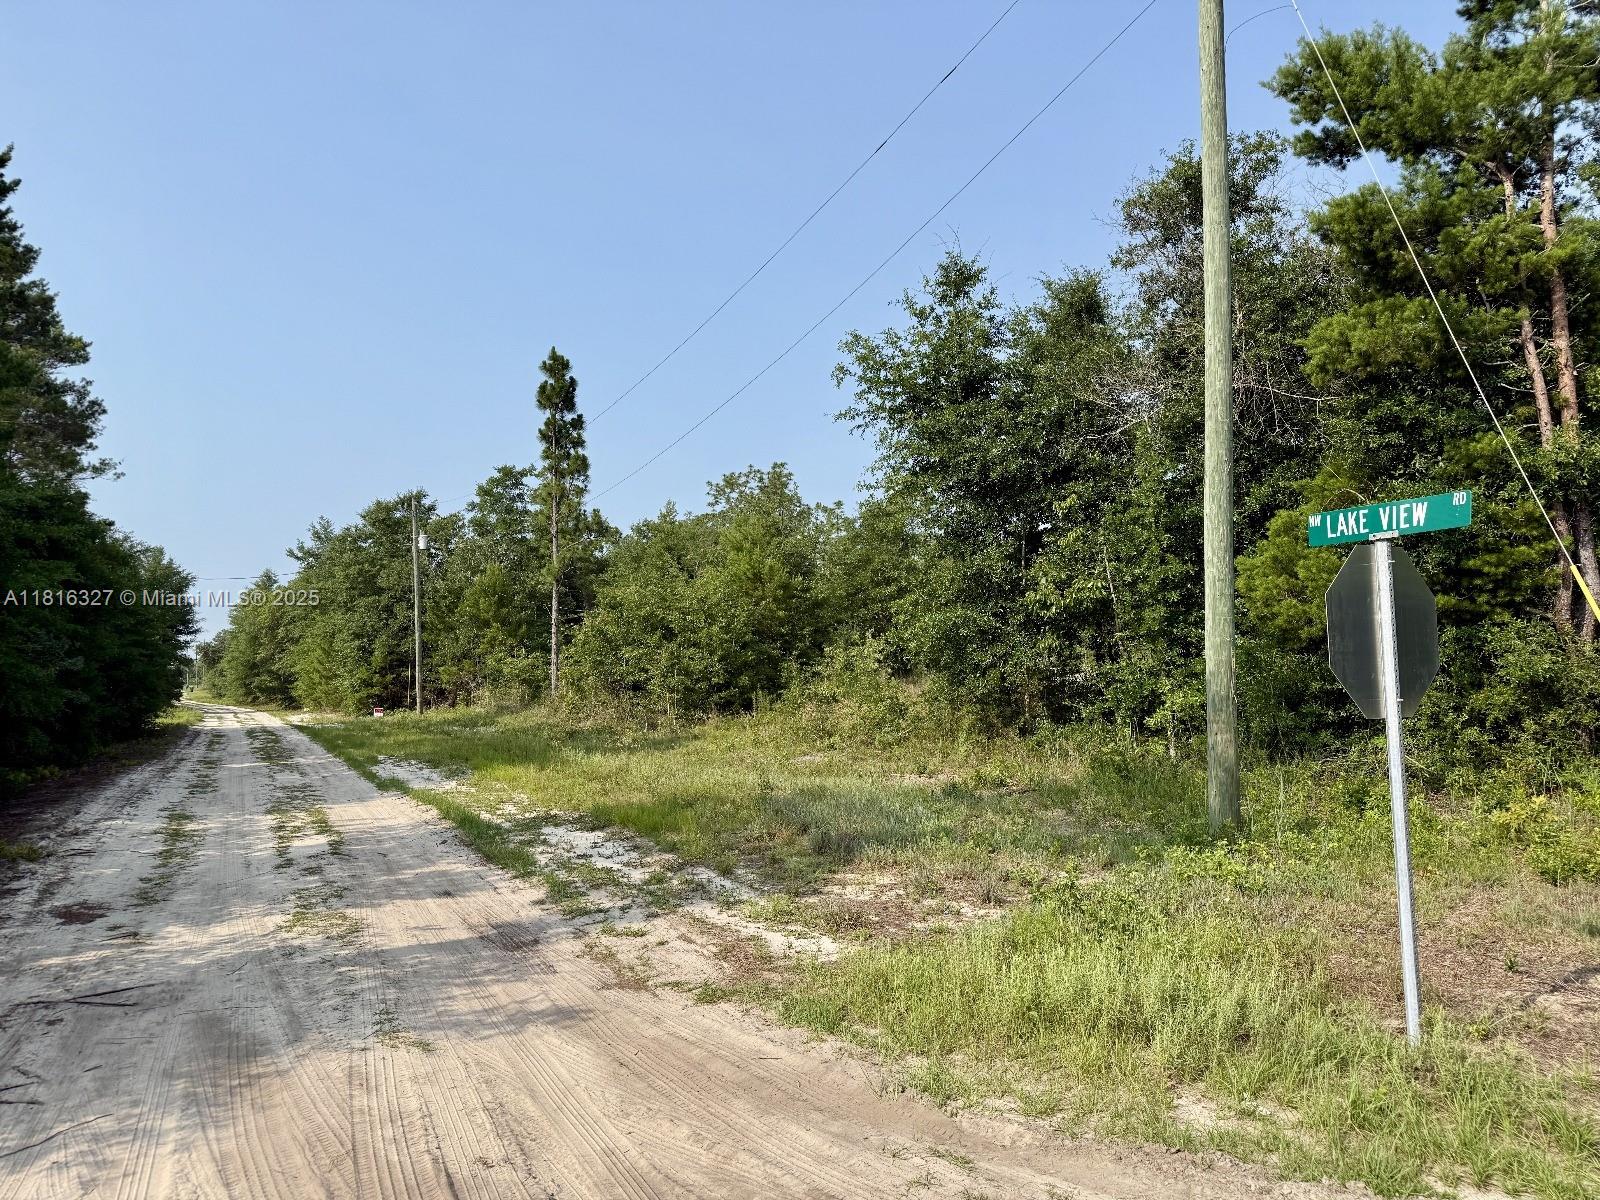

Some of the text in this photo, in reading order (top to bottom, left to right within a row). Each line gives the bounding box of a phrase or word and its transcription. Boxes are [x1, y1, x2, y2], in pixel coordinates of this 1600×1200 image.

[1308, 492, 1467, 538] NW LAKE VIEW RD
